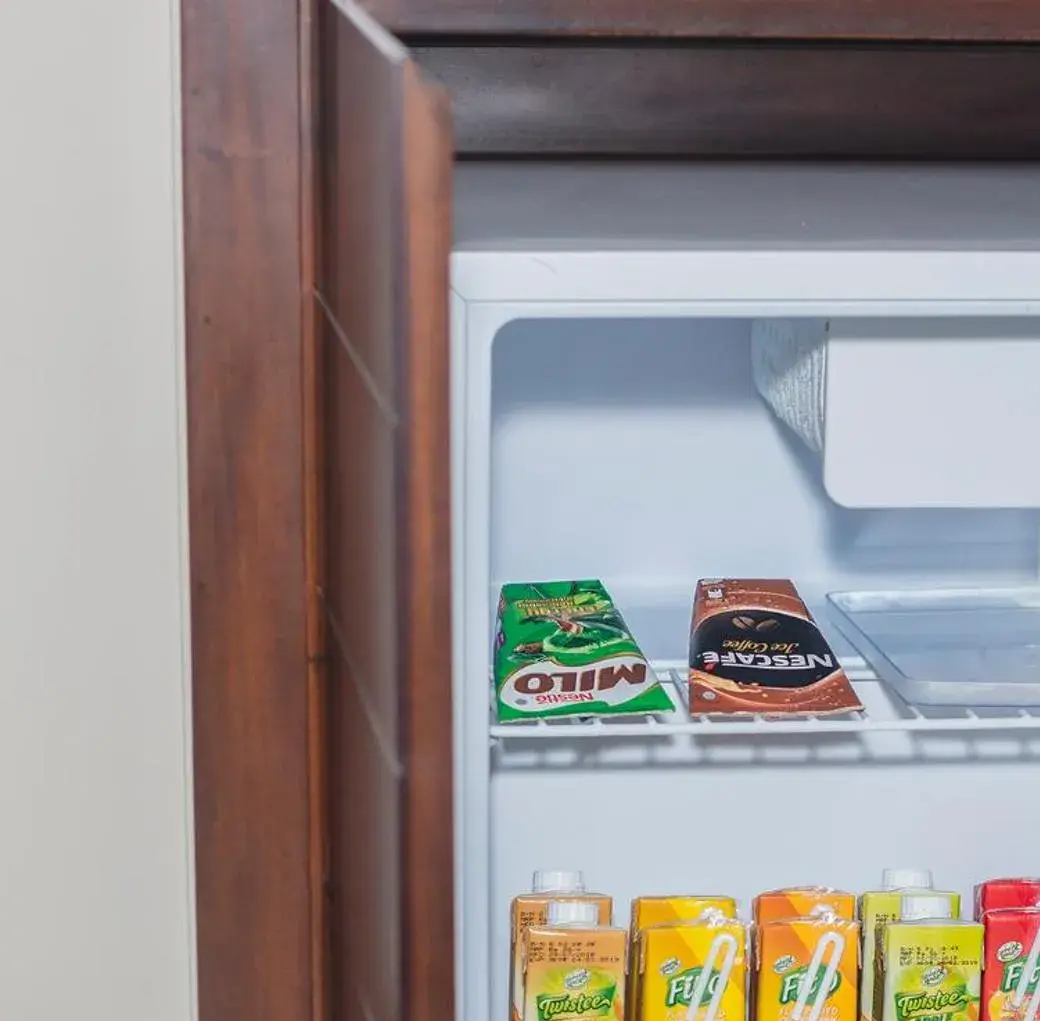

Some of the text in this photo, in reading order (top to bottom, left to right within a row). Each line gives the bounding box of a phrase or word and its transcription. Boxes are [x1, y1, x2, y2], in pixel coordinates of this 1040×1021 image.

[722, 639, 768, 653] Coffee
[514, 663, 646, 694] MILO
[539, 993, 611, 1020] Twistee
[898, 989, 967, 1018] Twistee
